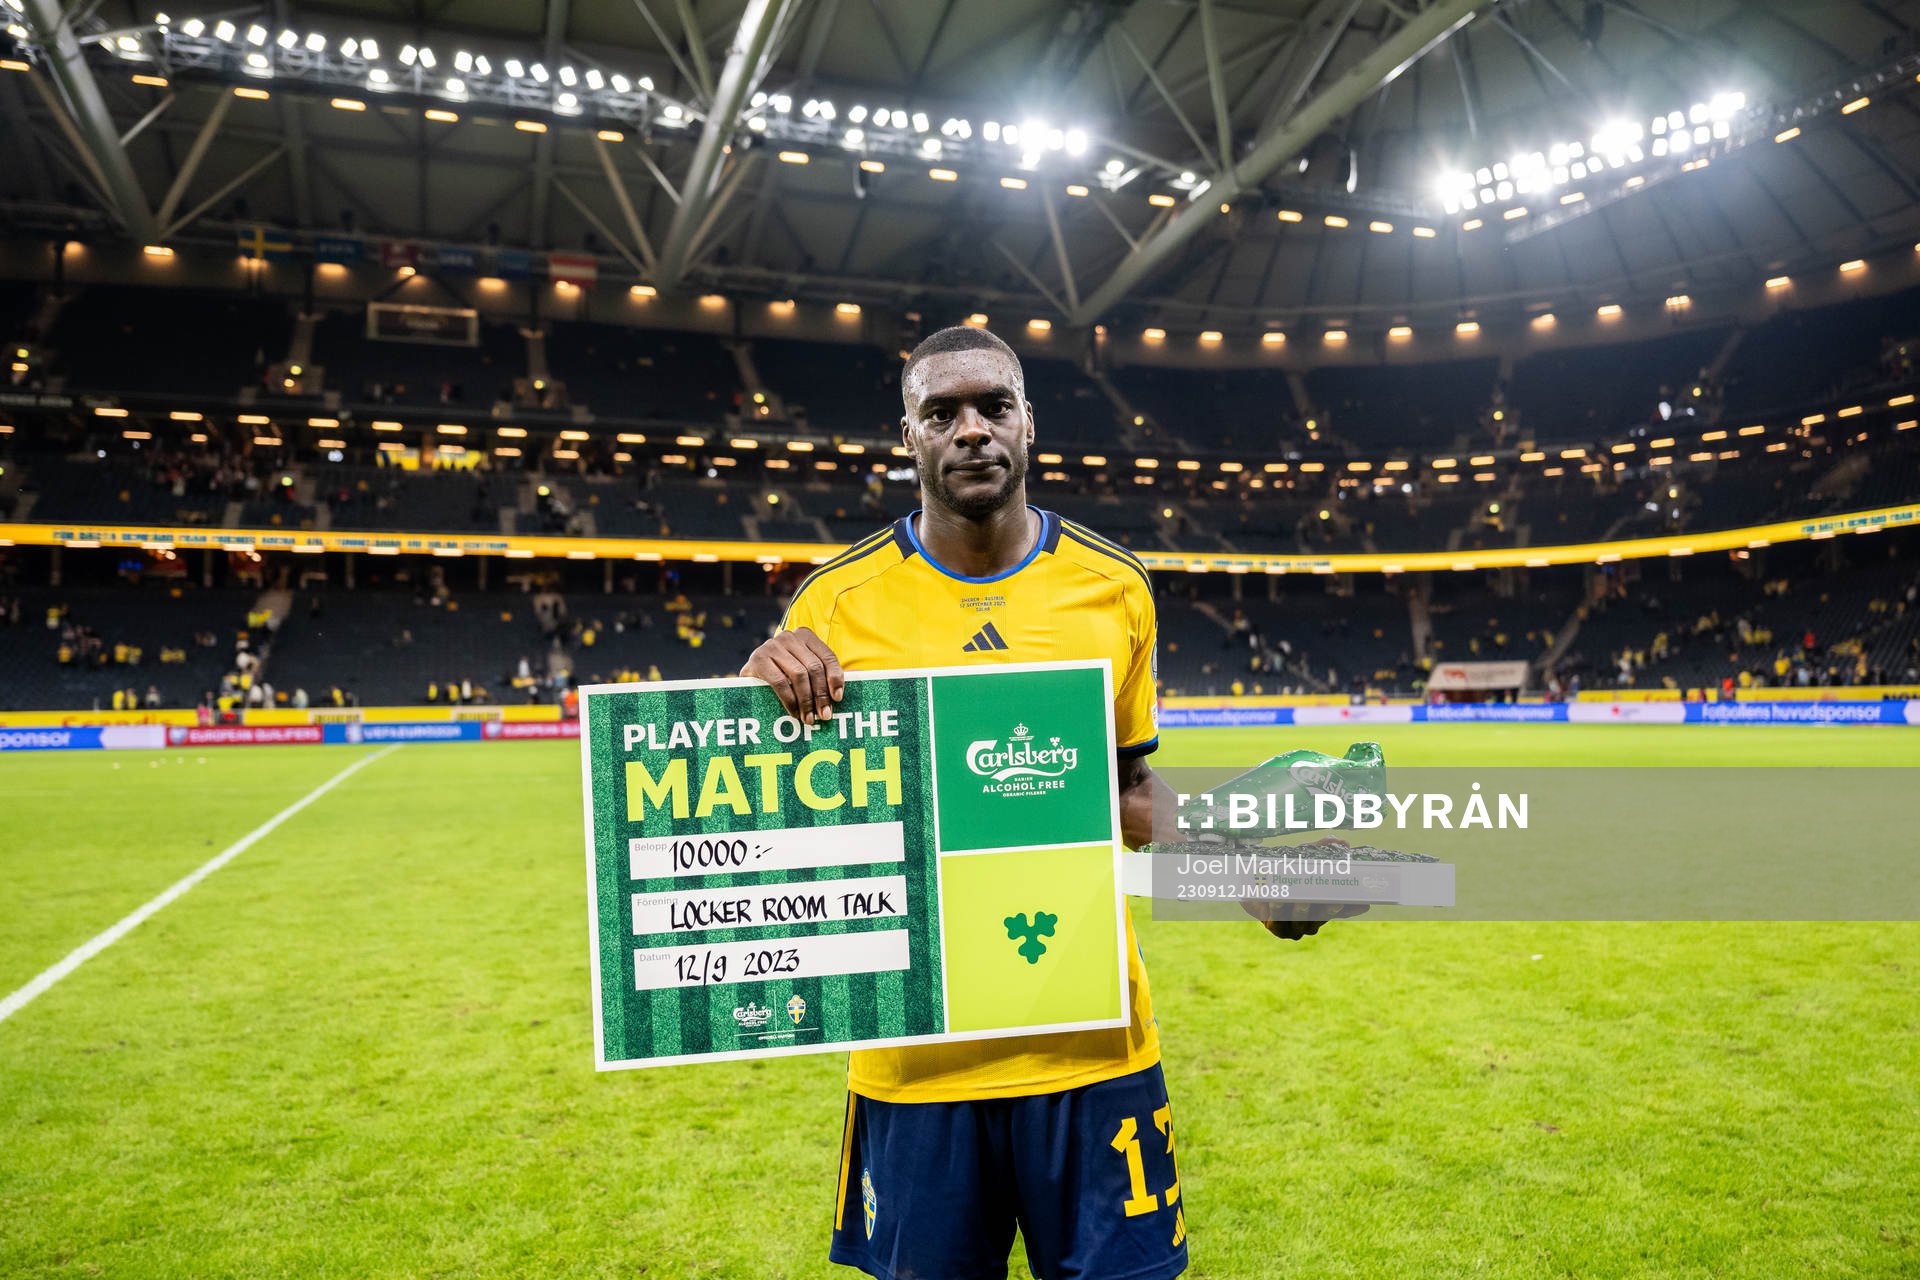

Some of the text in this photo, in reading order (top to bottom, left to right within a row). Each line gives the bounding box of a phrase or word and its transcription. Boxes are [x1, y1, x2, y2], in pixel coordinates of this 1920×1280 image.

[623, 710, 900, 751] PLAYER OF THE
[966, 740, 1078, 776] Carlsberg
[625, 746, 903, 822] MATCH
[982, 780, 1065, 793] ALCOHOL FREE
[634, 842, 668, 853] Belopp
[1272, 875, 1359, 887] Player of the match
[670, 891, 896, 930] LOCKER ROOM TALK
[639, 953, 671, 962] Datum
[674, 948, 800, 987] 12/9 2023
